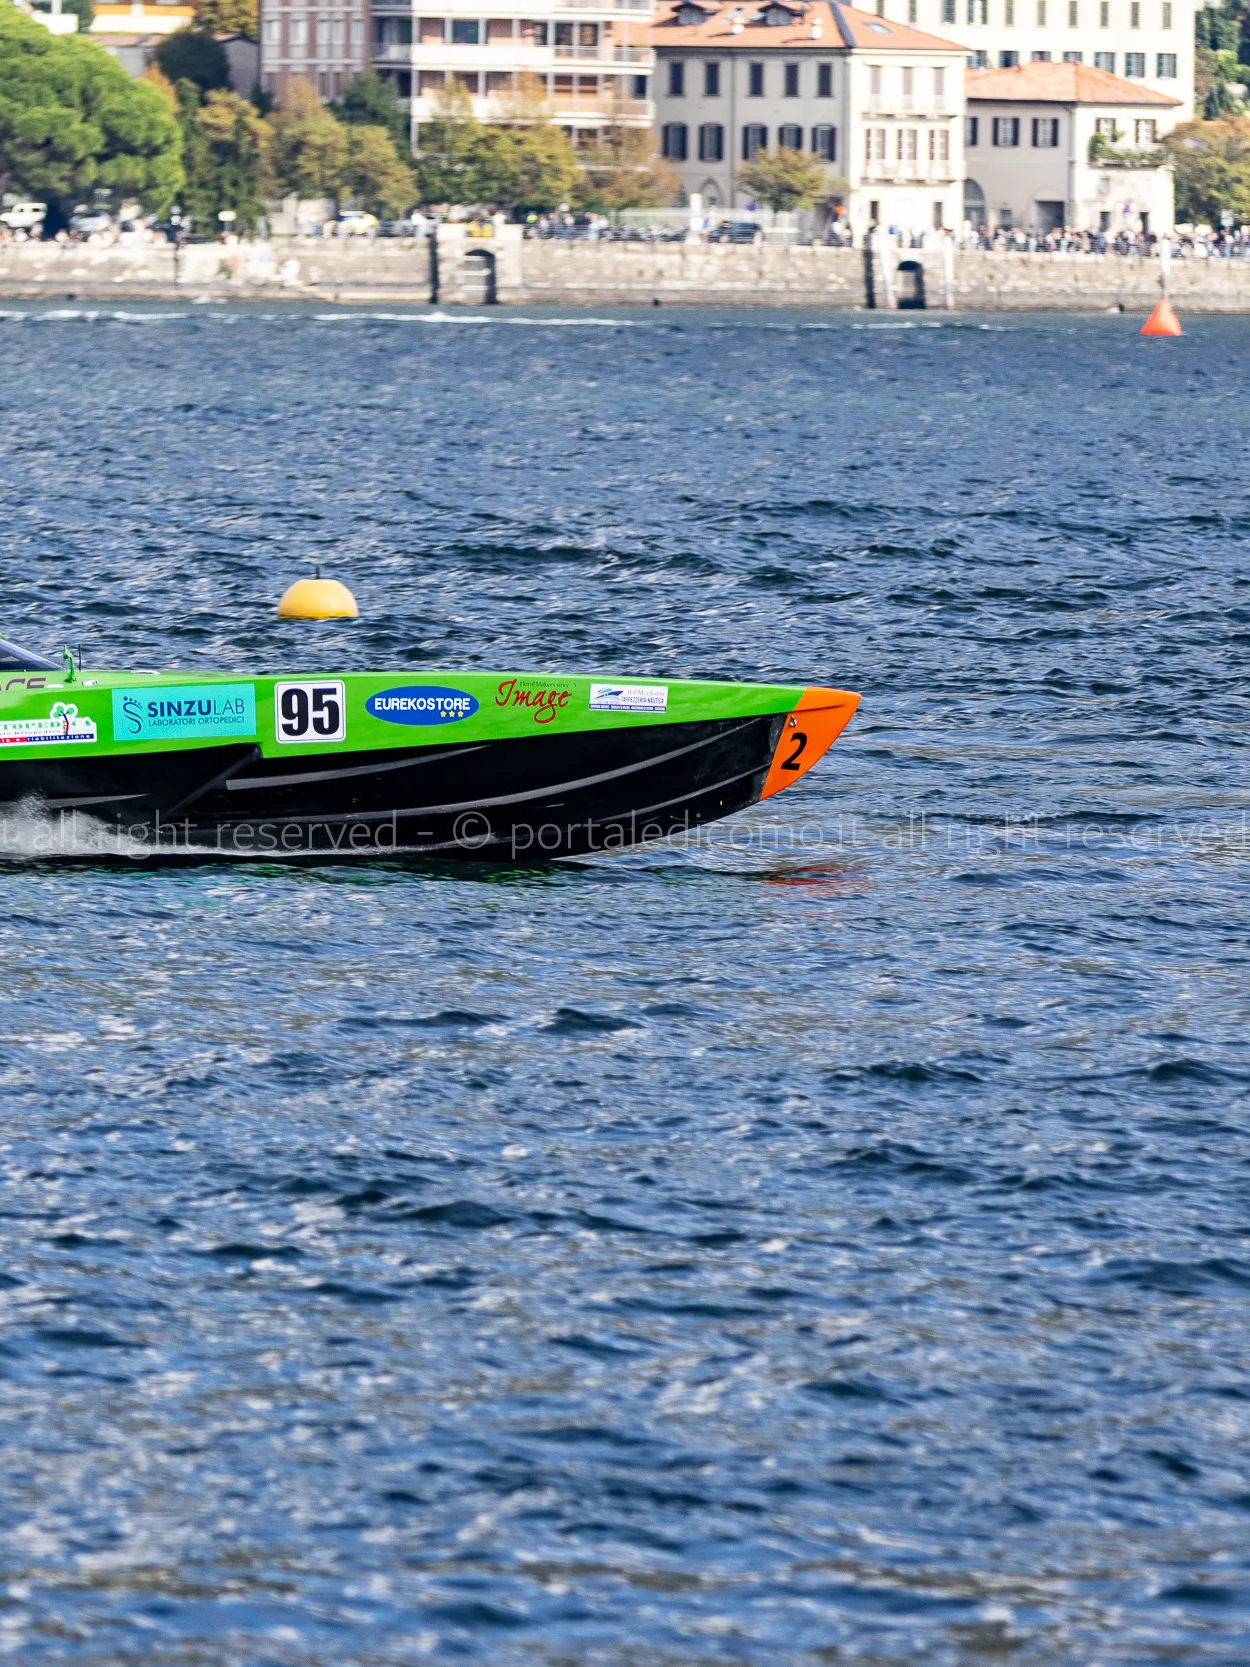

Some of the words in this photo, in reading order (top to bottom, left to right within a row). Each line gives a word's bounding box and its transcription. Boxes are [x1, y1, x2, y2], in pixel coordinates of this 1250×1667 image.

[147, 698, 245, 718] SINZULAB
[374, 697, 470, 711] EUREKOSTORE
[495, 678, 572, 724] Image
[148, 717, 196, 727] LABORATORI
[197, 715, 245, 725] ORTOPEDICI
[281, 687, 340, 737] 95
[27, 733, 91, 742] riabilitazione
[781, 732, 807, 771] 2
